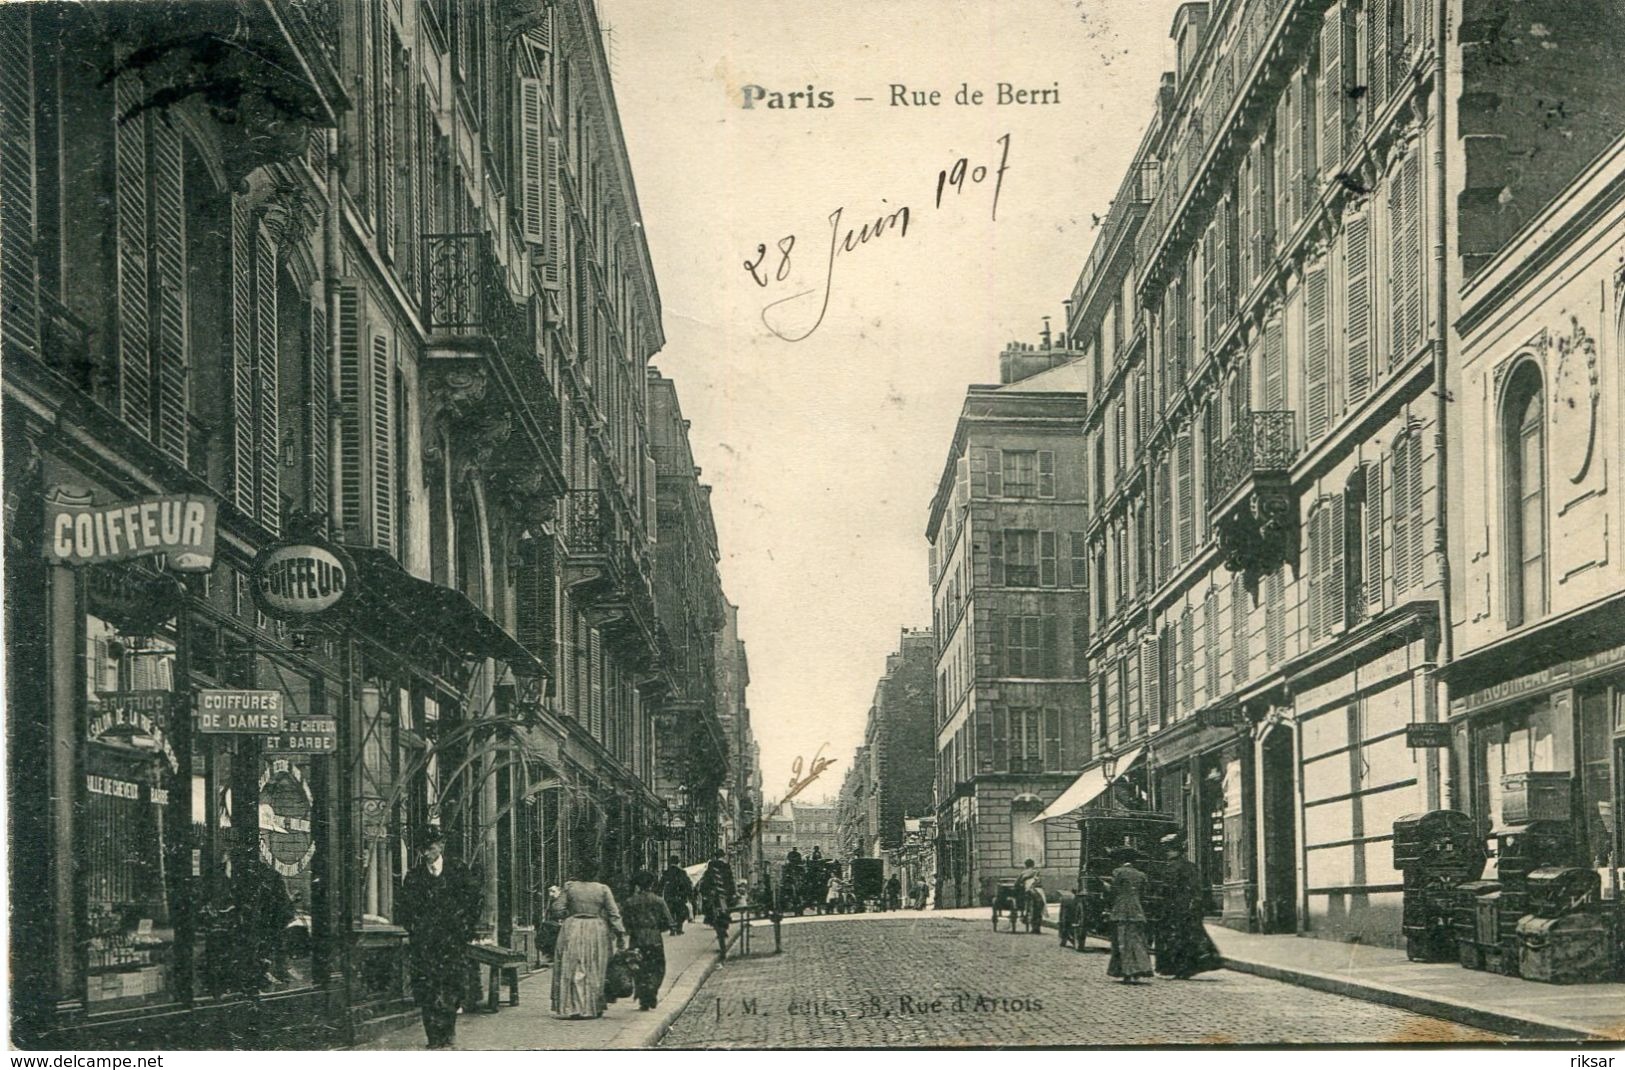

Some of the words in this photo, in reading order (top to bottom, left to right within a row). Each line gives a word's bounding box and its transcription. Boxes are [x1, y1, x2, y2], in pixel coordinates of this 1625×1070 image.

[936, 133, 1010, 221] 1907
[743, 235, 795, 287] 28
[761, 198, 909, 342] Juin
[54, 501, 206, 558] COIFFEUR
[259, 556, 344, 600] COIFFEUR
[202, 714, 220, 727] DE
[228, 714, 278, 728] DAMES
[204, 695, 277, 709] COIFFURES
[266, 736, 281, 748] ET
[289, 736, 331, 748] BARBE
